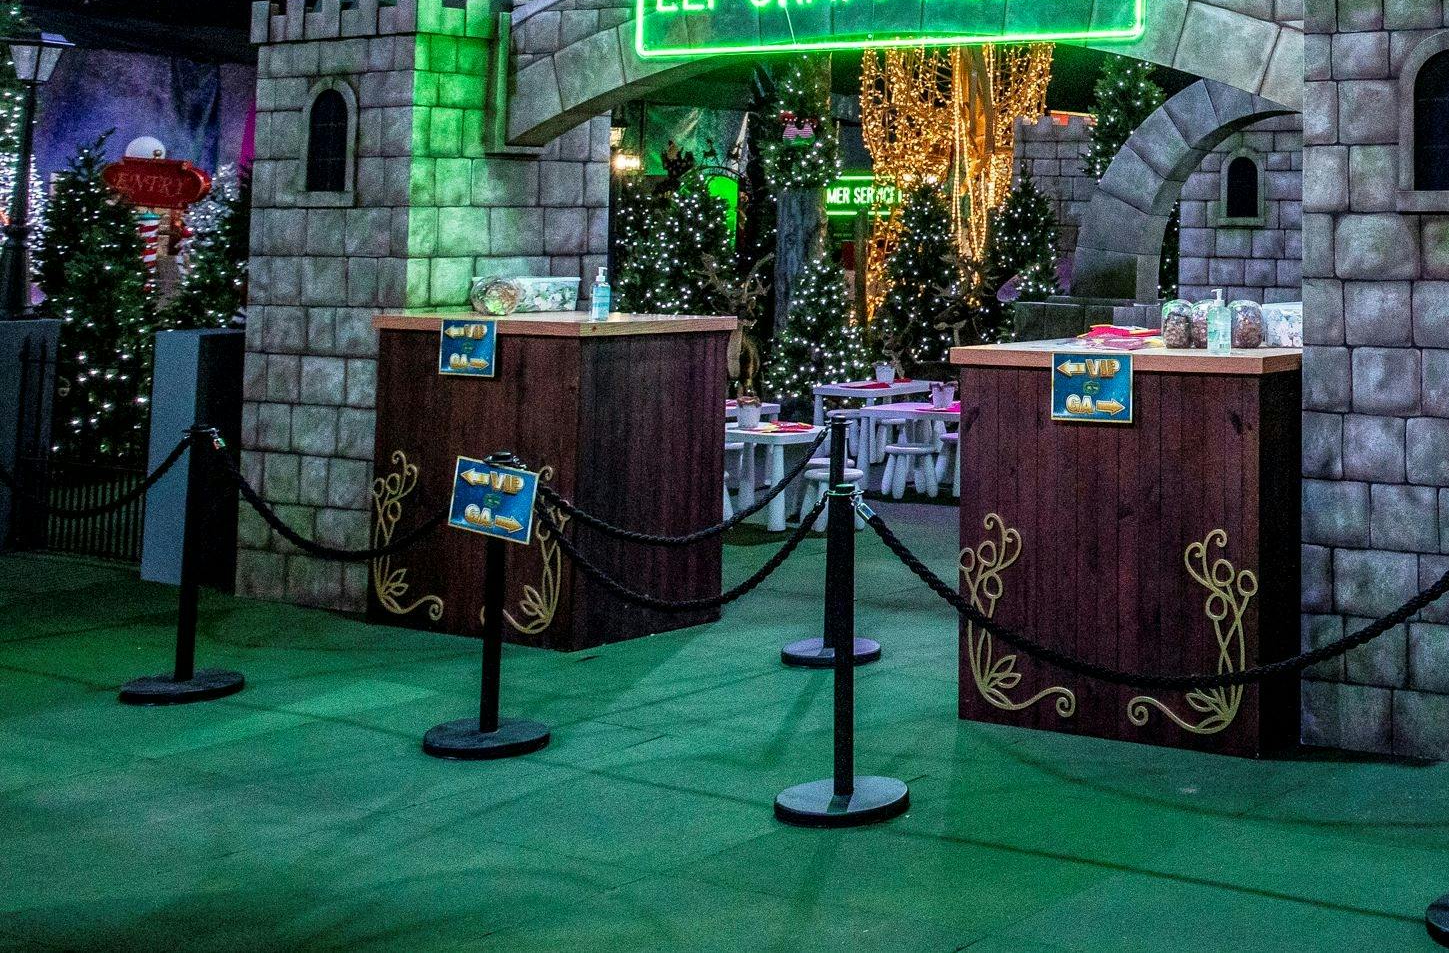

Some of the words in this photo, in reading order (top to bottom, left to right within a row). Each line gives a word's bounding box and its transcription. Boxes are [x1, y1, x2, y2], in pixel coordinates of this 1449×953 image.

[115, 171, 184, 197] ENTRY
[826, 187, 850, 204] MER
[464, 323, 487, 340] VIP
[449, 353, 468, 369] GA
[1085, 358, 1121, 378] VIP
[1066, 393, 1097, 414] GA
[489, 470, 525, 495] VIP
[464, 503, 494, 528] GA
